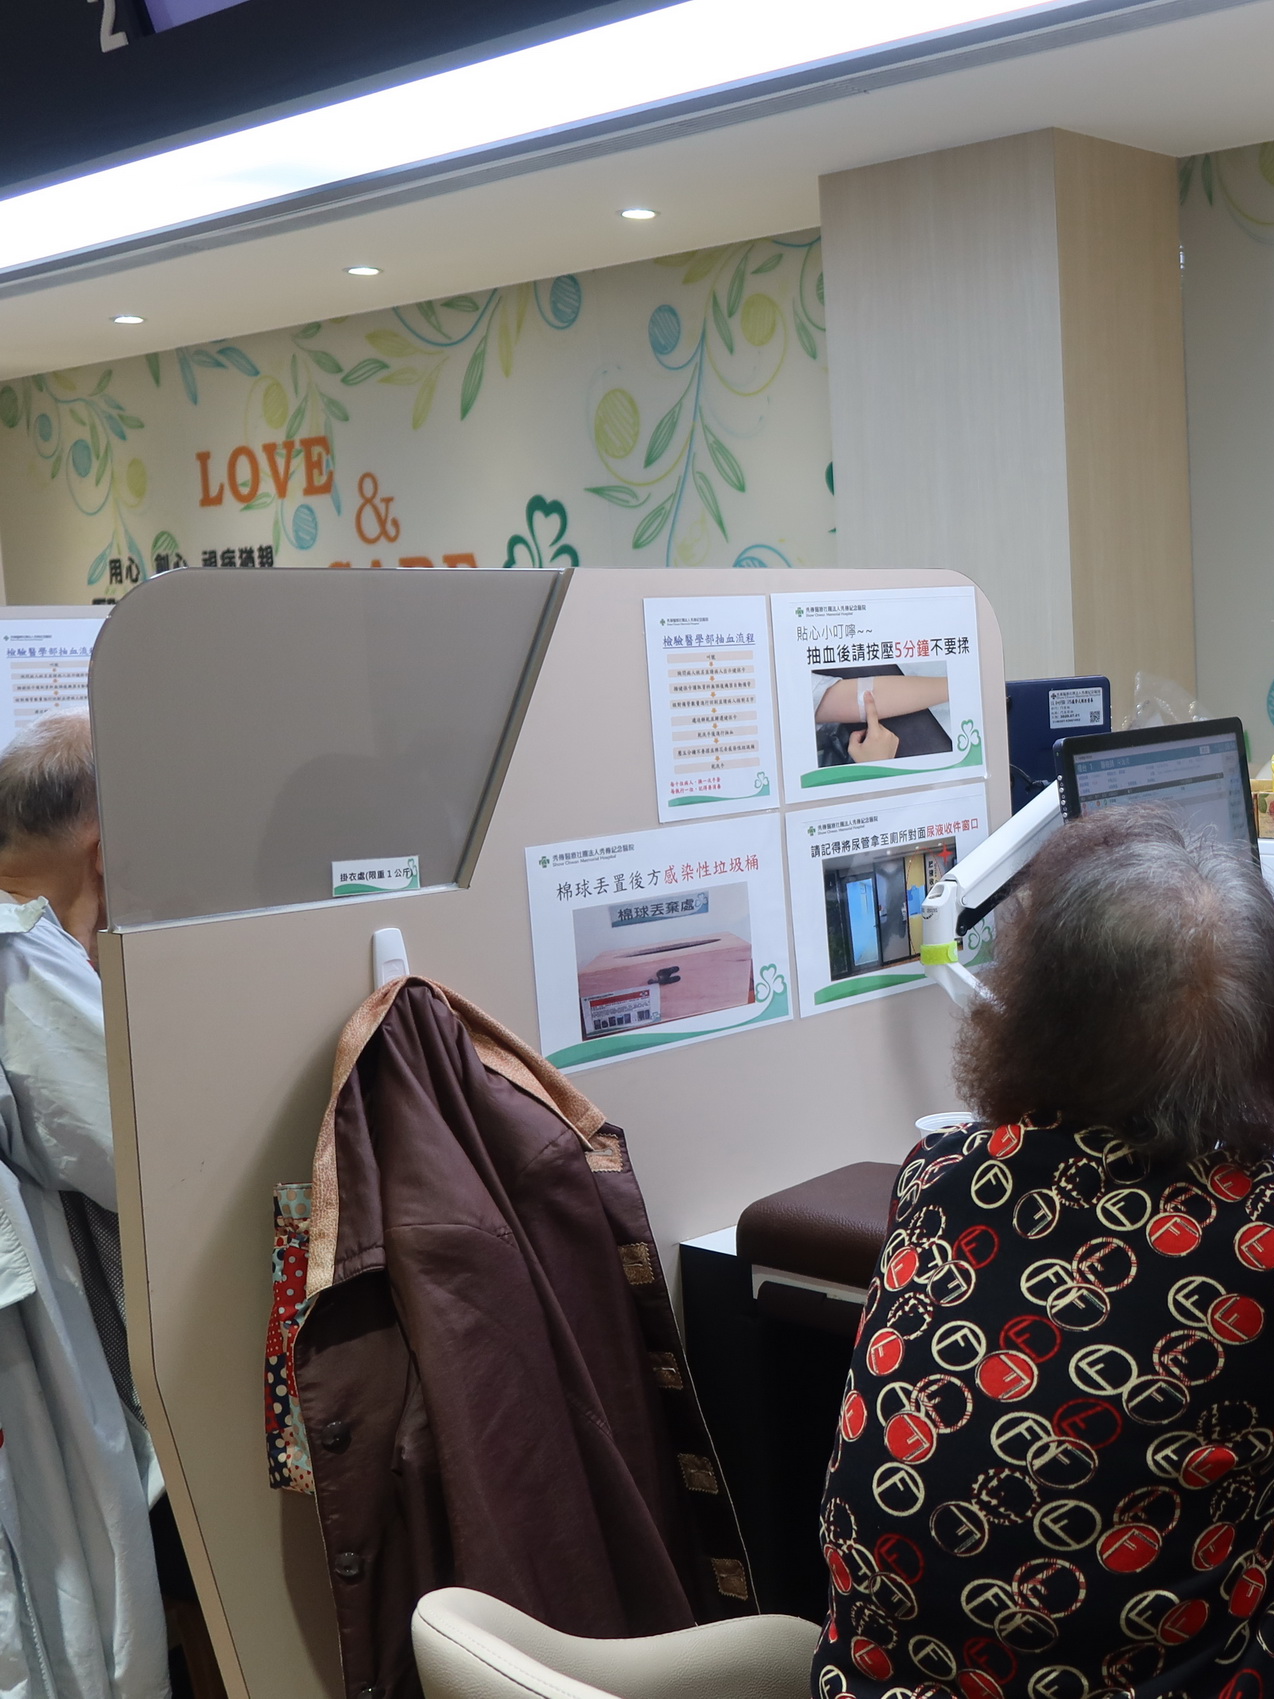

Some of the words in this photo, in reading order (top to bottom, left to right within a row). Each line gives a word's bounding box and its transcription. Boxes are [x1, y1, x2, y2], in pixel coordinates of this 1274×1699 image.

[196, 435, 334, 508] LOVE
[353, 471, 401, 545] &
[108, 556, 141, 585] 用心
[662, 632, 756, 647] 檢驗醫學部抽血流程
[806, 636, 971, 665] 抽血後請按壓5分鐘不要揉
[556, 854, 760, 902] 棉球丟置後方感染性垃圾桶
[617, 898, 696, 922] 棉球丟棄處
